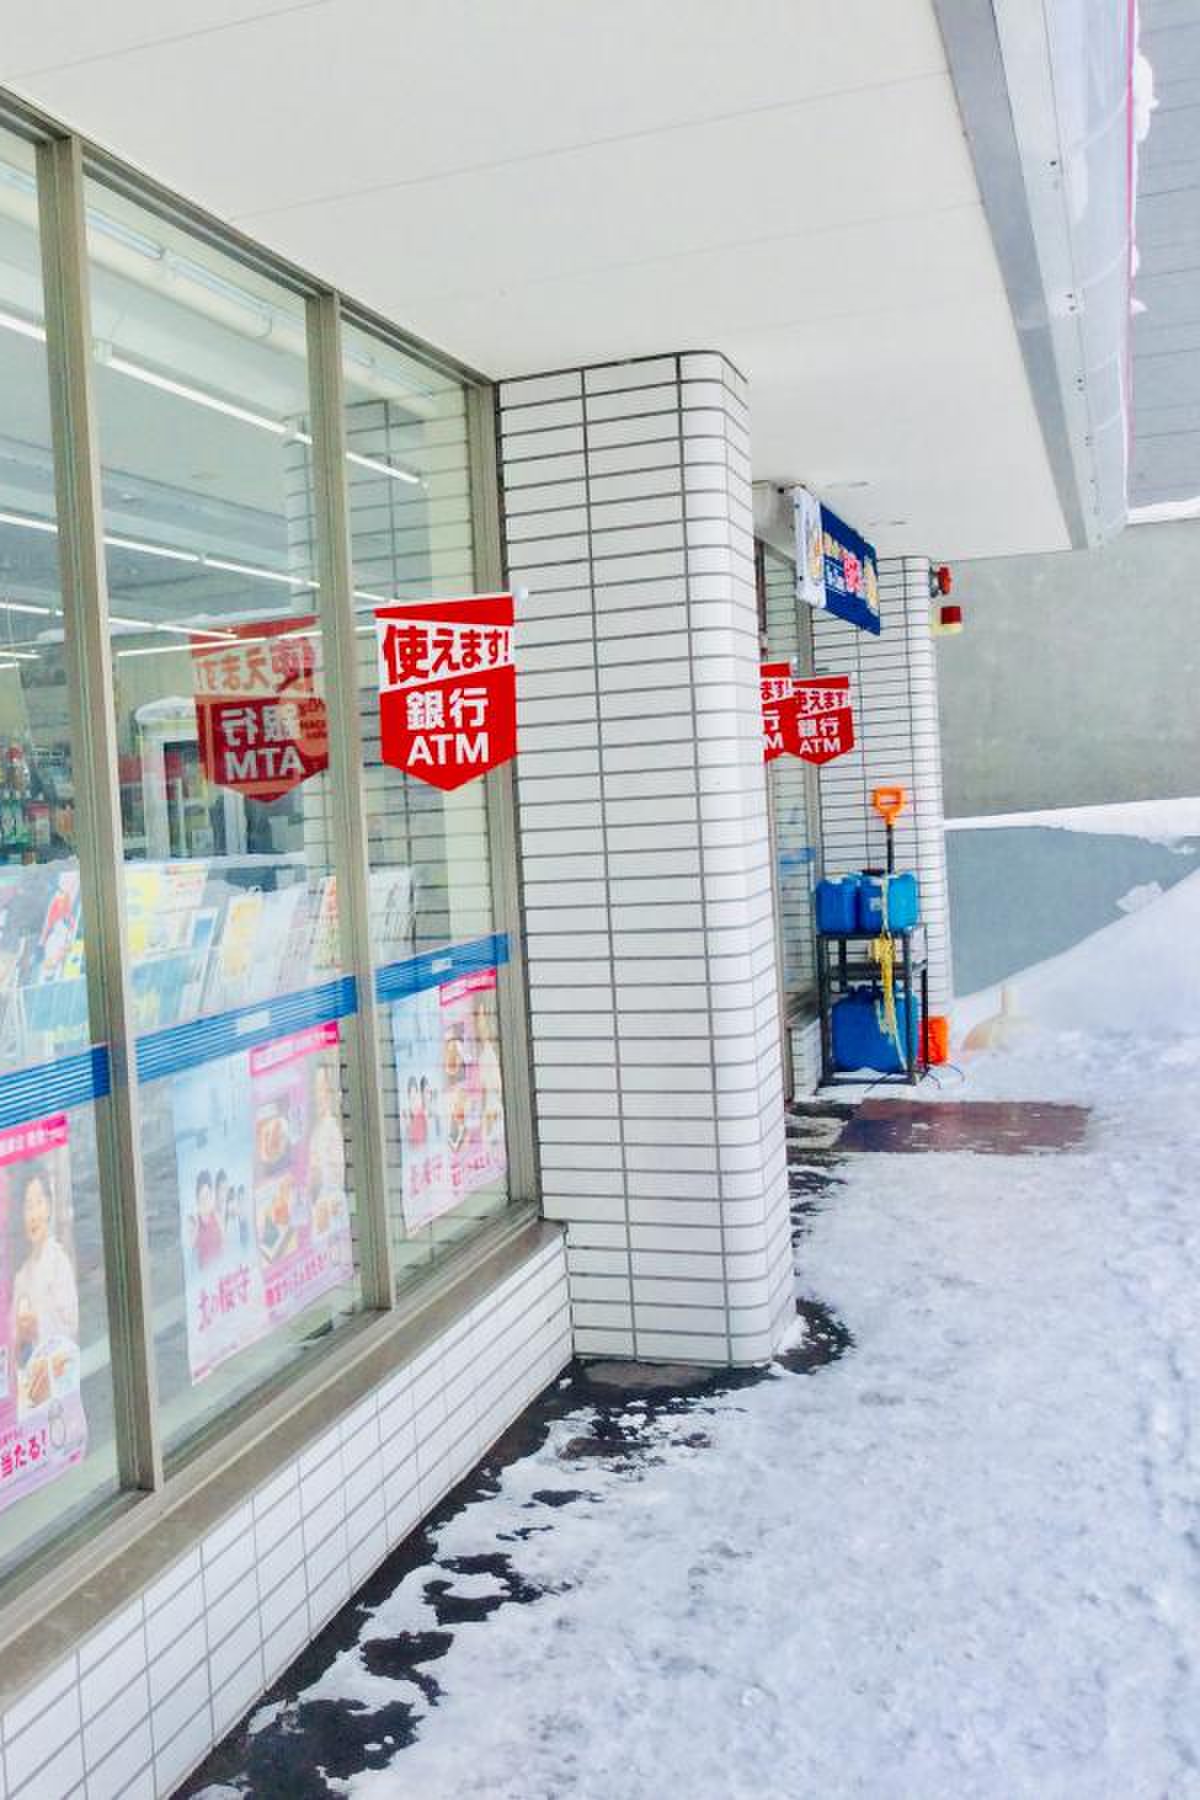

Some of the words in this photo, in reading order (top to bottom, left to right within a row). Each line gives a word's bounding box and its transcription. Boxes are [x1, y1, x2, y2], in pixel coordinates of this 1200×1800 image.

[383, 624, 509, 685] 使えます!
[406, 687, 489, 730] 銀行
[798, 717, 840, 737] 銀行
[406, 732, 490, 767] ATM
[800, 738, 841, 755] ATM
